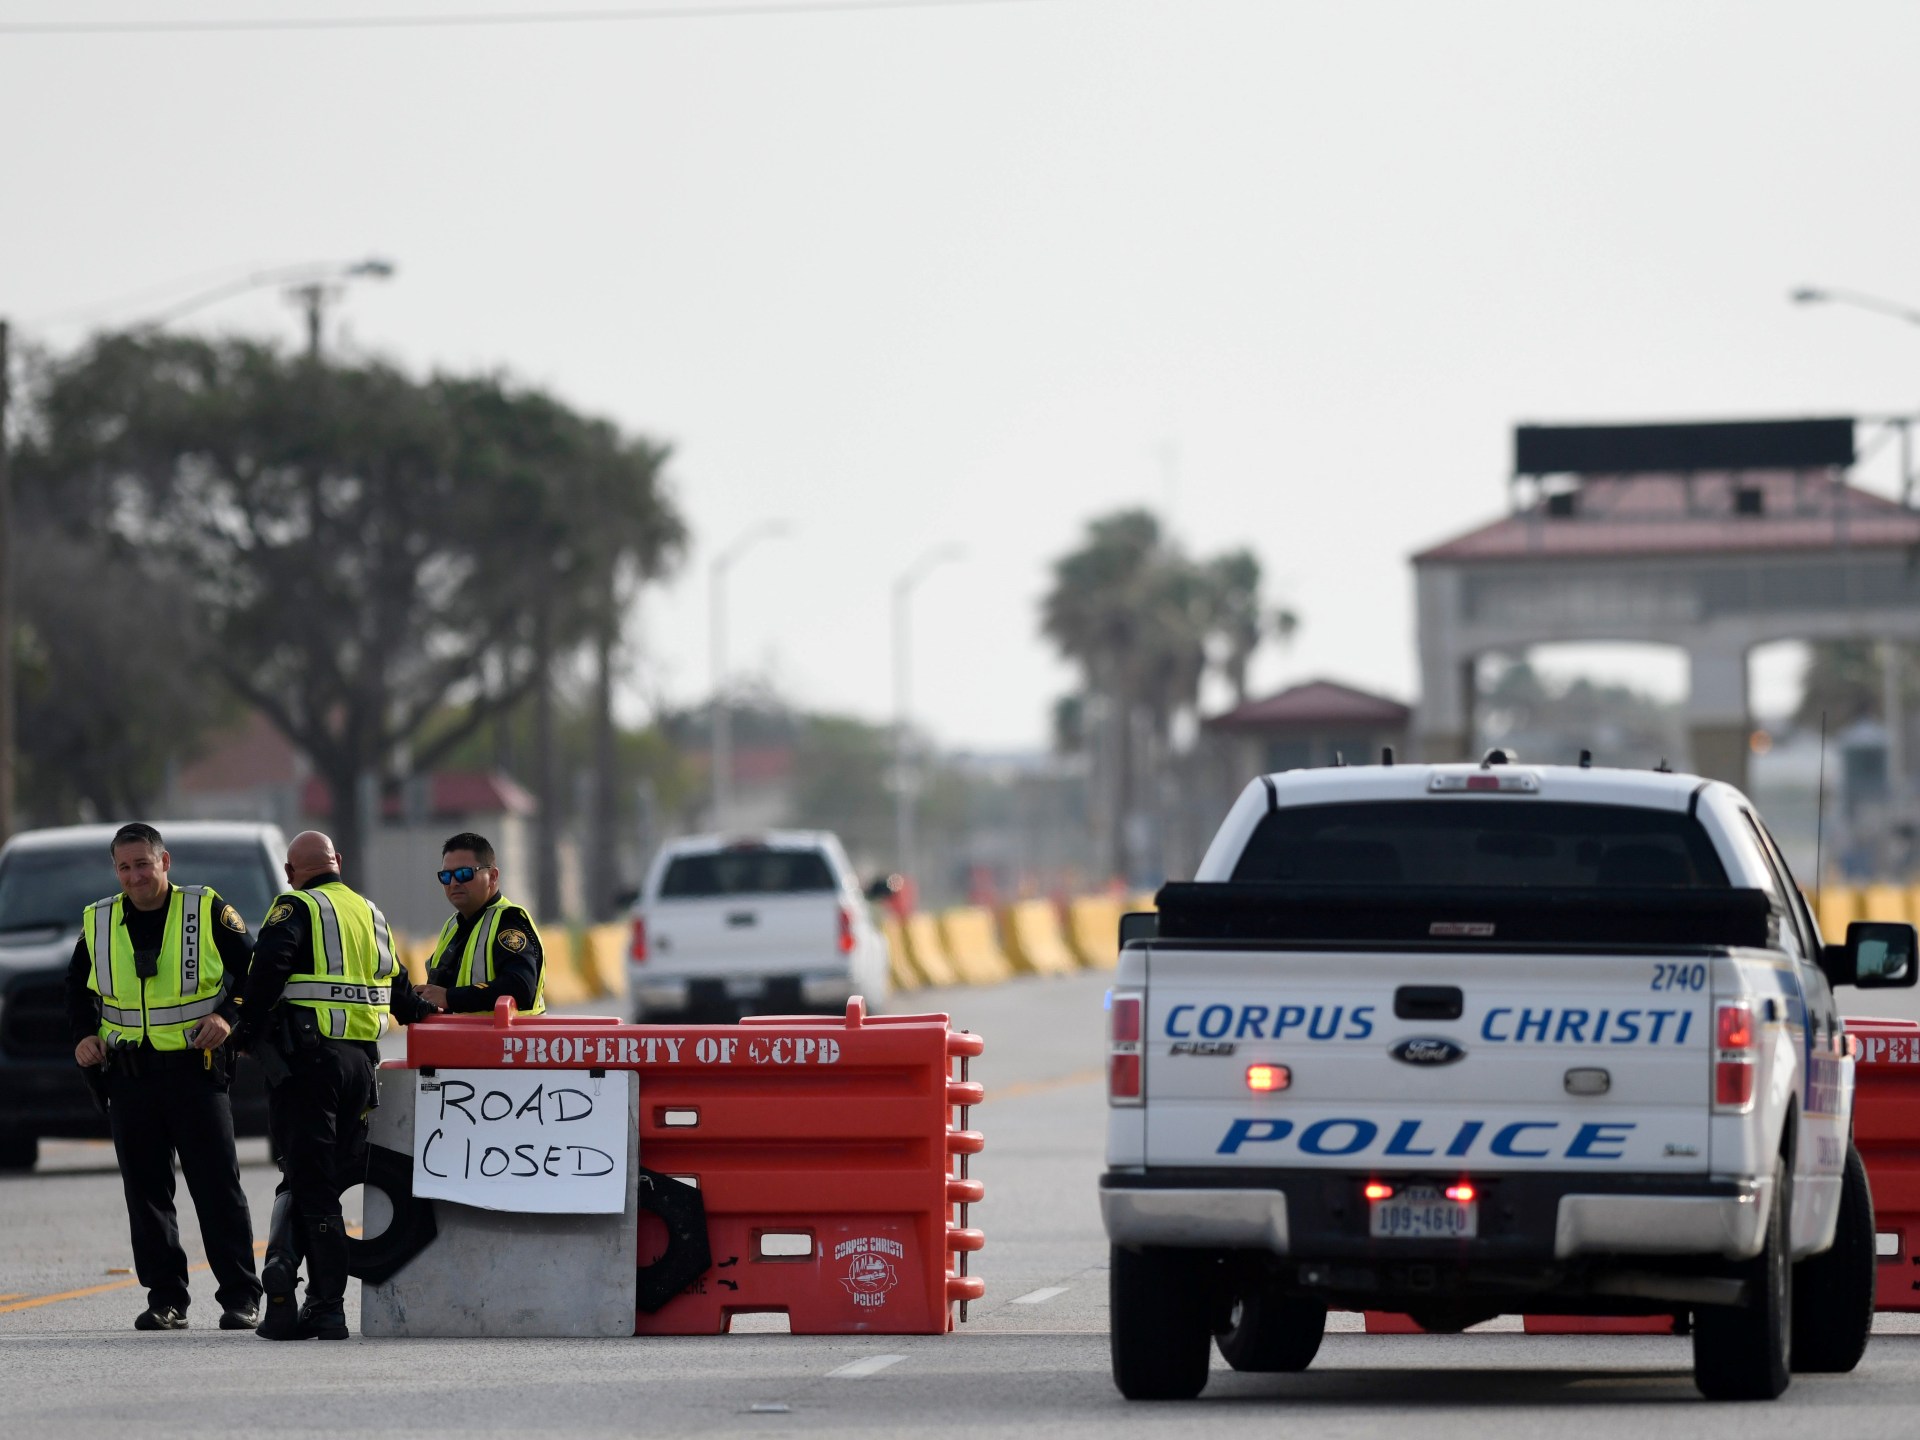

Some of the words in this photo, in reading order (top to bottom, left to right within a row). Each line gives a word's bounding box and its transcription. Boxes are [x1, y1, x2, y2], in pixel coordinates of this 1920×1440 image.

[184, 913, 197, 980] POLICE
[1650, 963, 1706, 992] 2740
[330, 985, 386, 1003] POLCE
[1163, 1003, 1376, 1041] CORPUS
[1480, 1007, 1693, 1045] CHRISTI
[501, 1037, 685, 1063] PROPERTY
[695, 1037, 739, 1064] OF
[749, 1037, 841, 1064] CCPD
[1404, 1040, 1450, 1061] Ford
[440, 1080, 593, 1125] ROAD
[1214, 1117, 1638, 1159] POLICE
[834, 1236, 868, 1260] CORPUS
[869, 1236, 904, 1260] CHRISTI
[853, 1291, 886, 1307] POLICE
